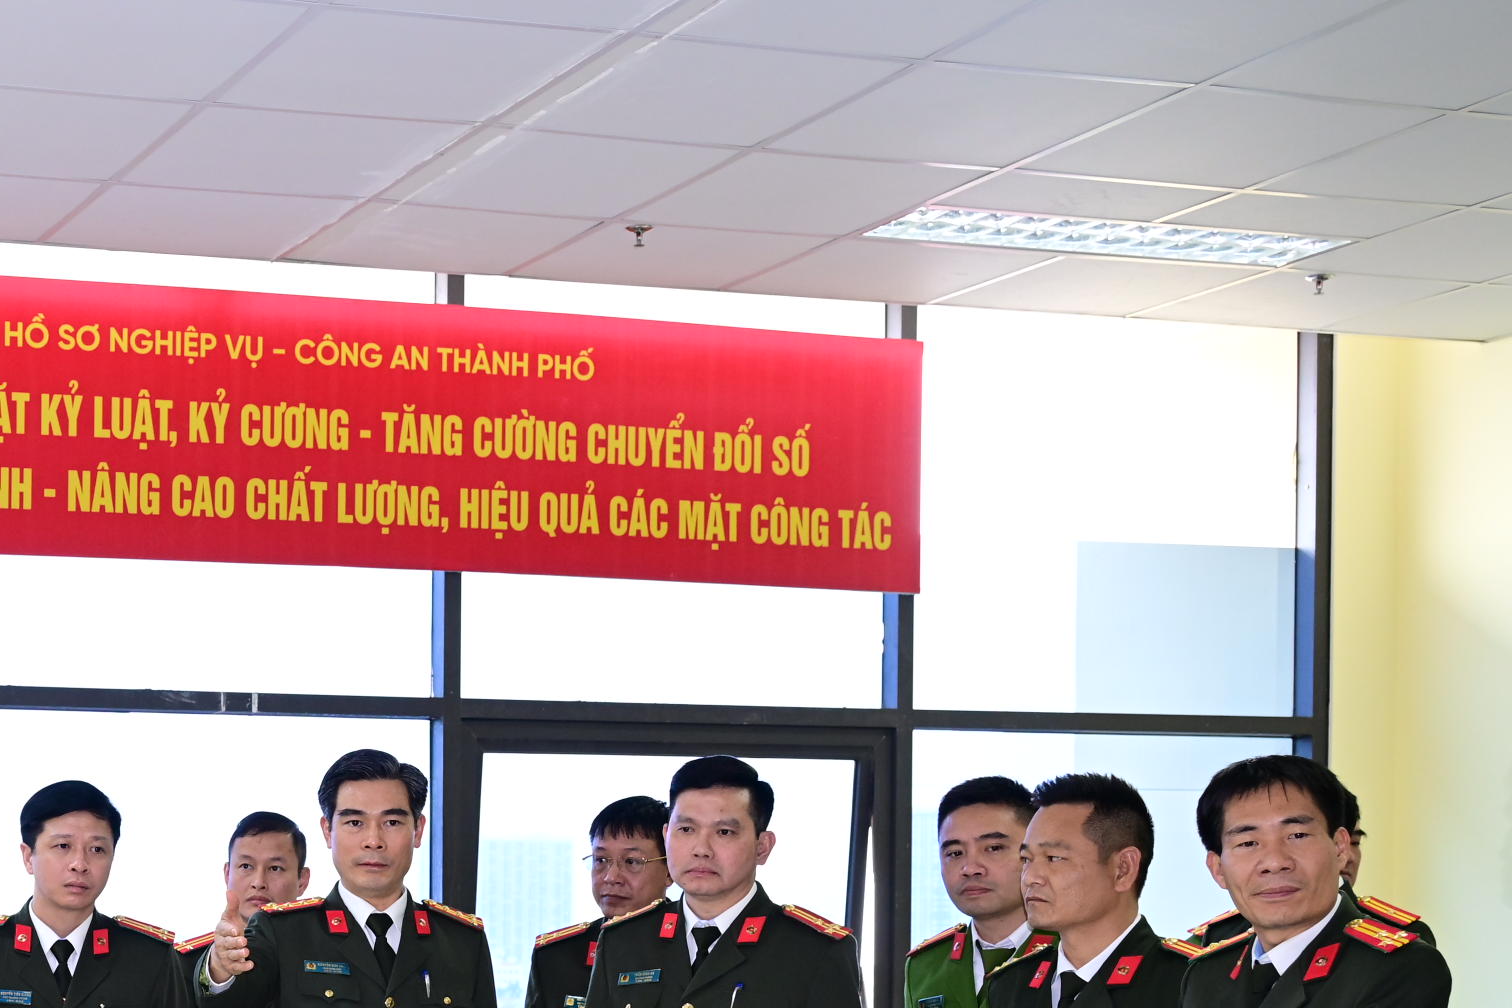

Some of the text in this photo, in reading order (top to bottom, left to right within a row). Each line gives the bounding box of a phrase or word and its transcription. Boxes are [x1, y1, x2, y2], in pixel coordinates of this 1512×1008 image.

[4, 312, 50, 349] HỒ
[57, 323, 101, 352] SƠ
[109, 325, 218, 365] NGHIỆP
[224, 334, 264, 369] VỤ
[294, 333, 383, 369] CÔNG
[389, 344, 429, 371] AN
[436, 343, 529, 377] THÀNH
[537, 347, 595, 381] PHỐ
[40, 379, 84, 437] KỶ
[93, 388, 178, 450] LUẬT,
[188, 387, 231, 444] KỶ
[240, 401, 350, 451] CƯƠNG
[381, 403, 463, 457] TĂNG
[473, 408, 577, 463] CƯỜNG
[587, 412, 705, 470] CHUYỂN
[712, 417, 762, 474] ĐỔI
[771, 423, 812, 477] SỐ
[67, 461, 161, 516] NÂNG
[171, 474, 235, 519] CAO
[245, 465, 328, 523] CHẤT
[337, 479, 449, 535] LƯỢNG,
[459, 480, 529, 540] HIỆU
[539, 480, 600, 537] QUẢ
[609, 488, 669, 539] CÁC
[678, 493, 742, 551] MẶT
[750, 497, 830, 548] CÔNG
[837, 501, 892, 551] TÁC
